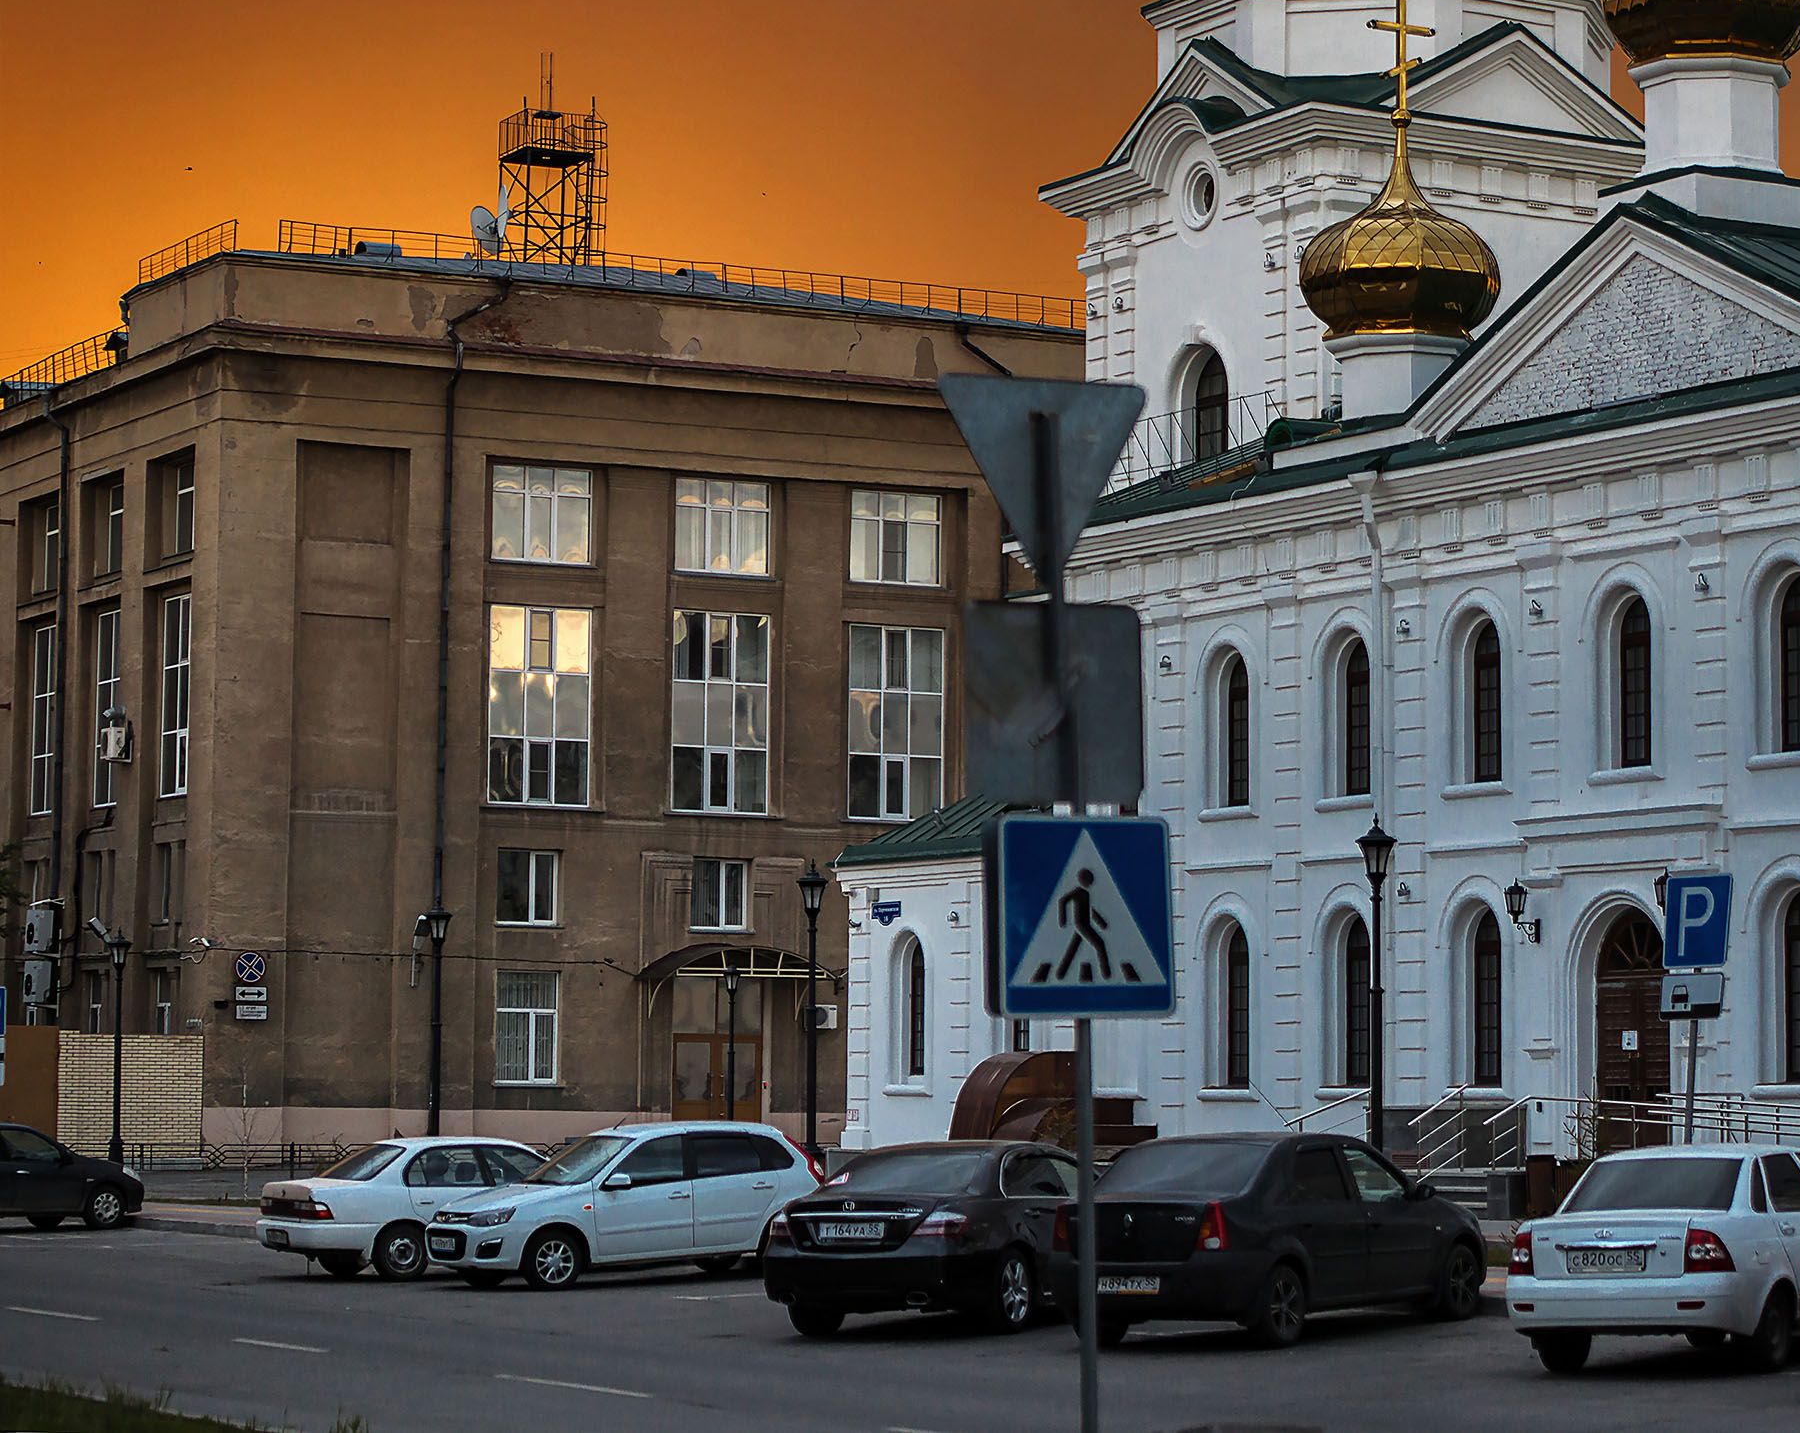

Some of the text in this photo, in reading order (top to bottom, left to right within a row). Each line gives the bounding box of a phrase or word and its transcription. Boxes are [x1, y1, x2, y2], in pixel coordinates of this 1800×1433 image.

[1678, 886, 1715, 957] P
[868, 1223, 879, 1233] 55
[1627, 1251, 1640, 1262] 55
